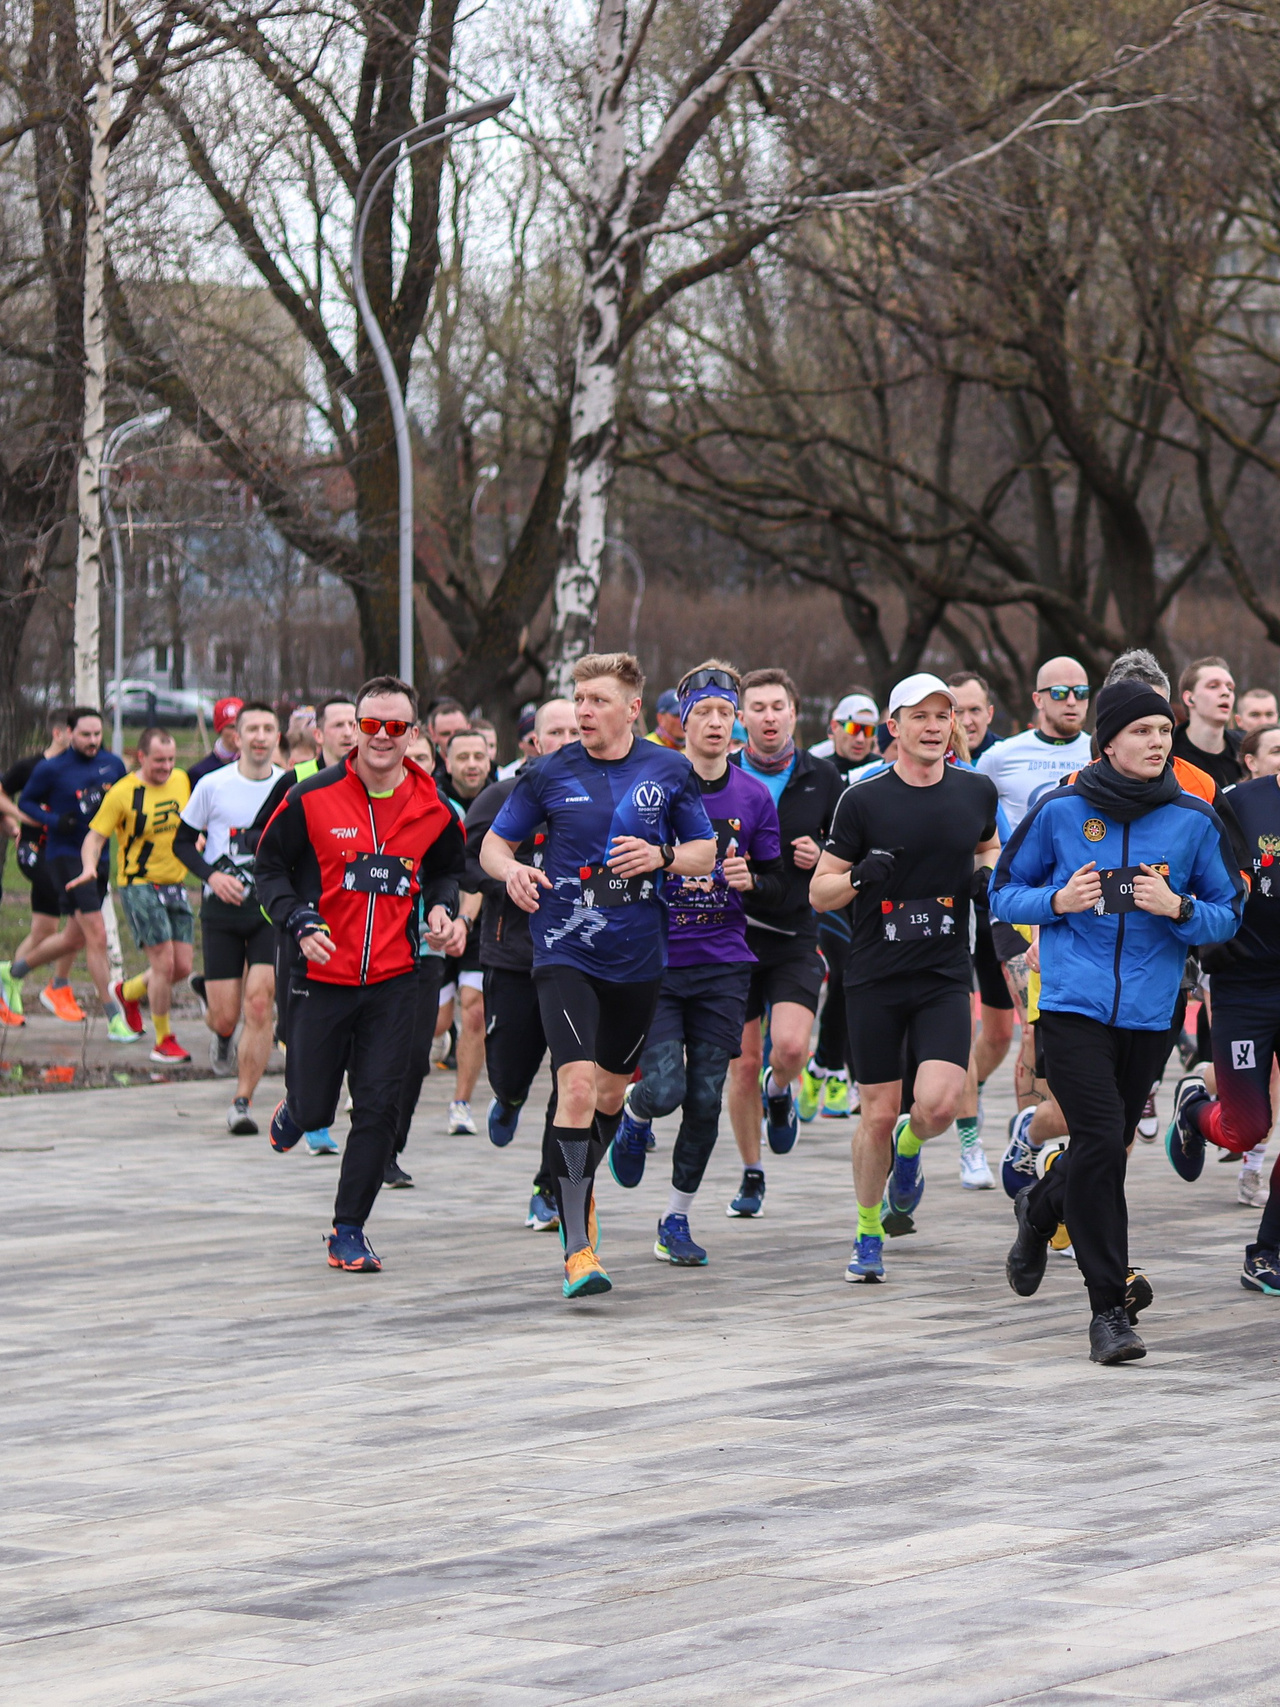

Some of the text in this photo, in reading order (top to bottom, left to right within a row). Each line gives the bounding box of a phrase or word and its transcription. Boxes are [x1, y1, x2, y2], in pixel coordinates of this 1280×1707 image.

[1027, 760, 1056, 771] ДОРОГА
[370, 866, 389, 880] 068
[608, 879, 629, 890] 057
[1119, 882, 1136, 895] 01
[909, 912, 930, 925] 135
